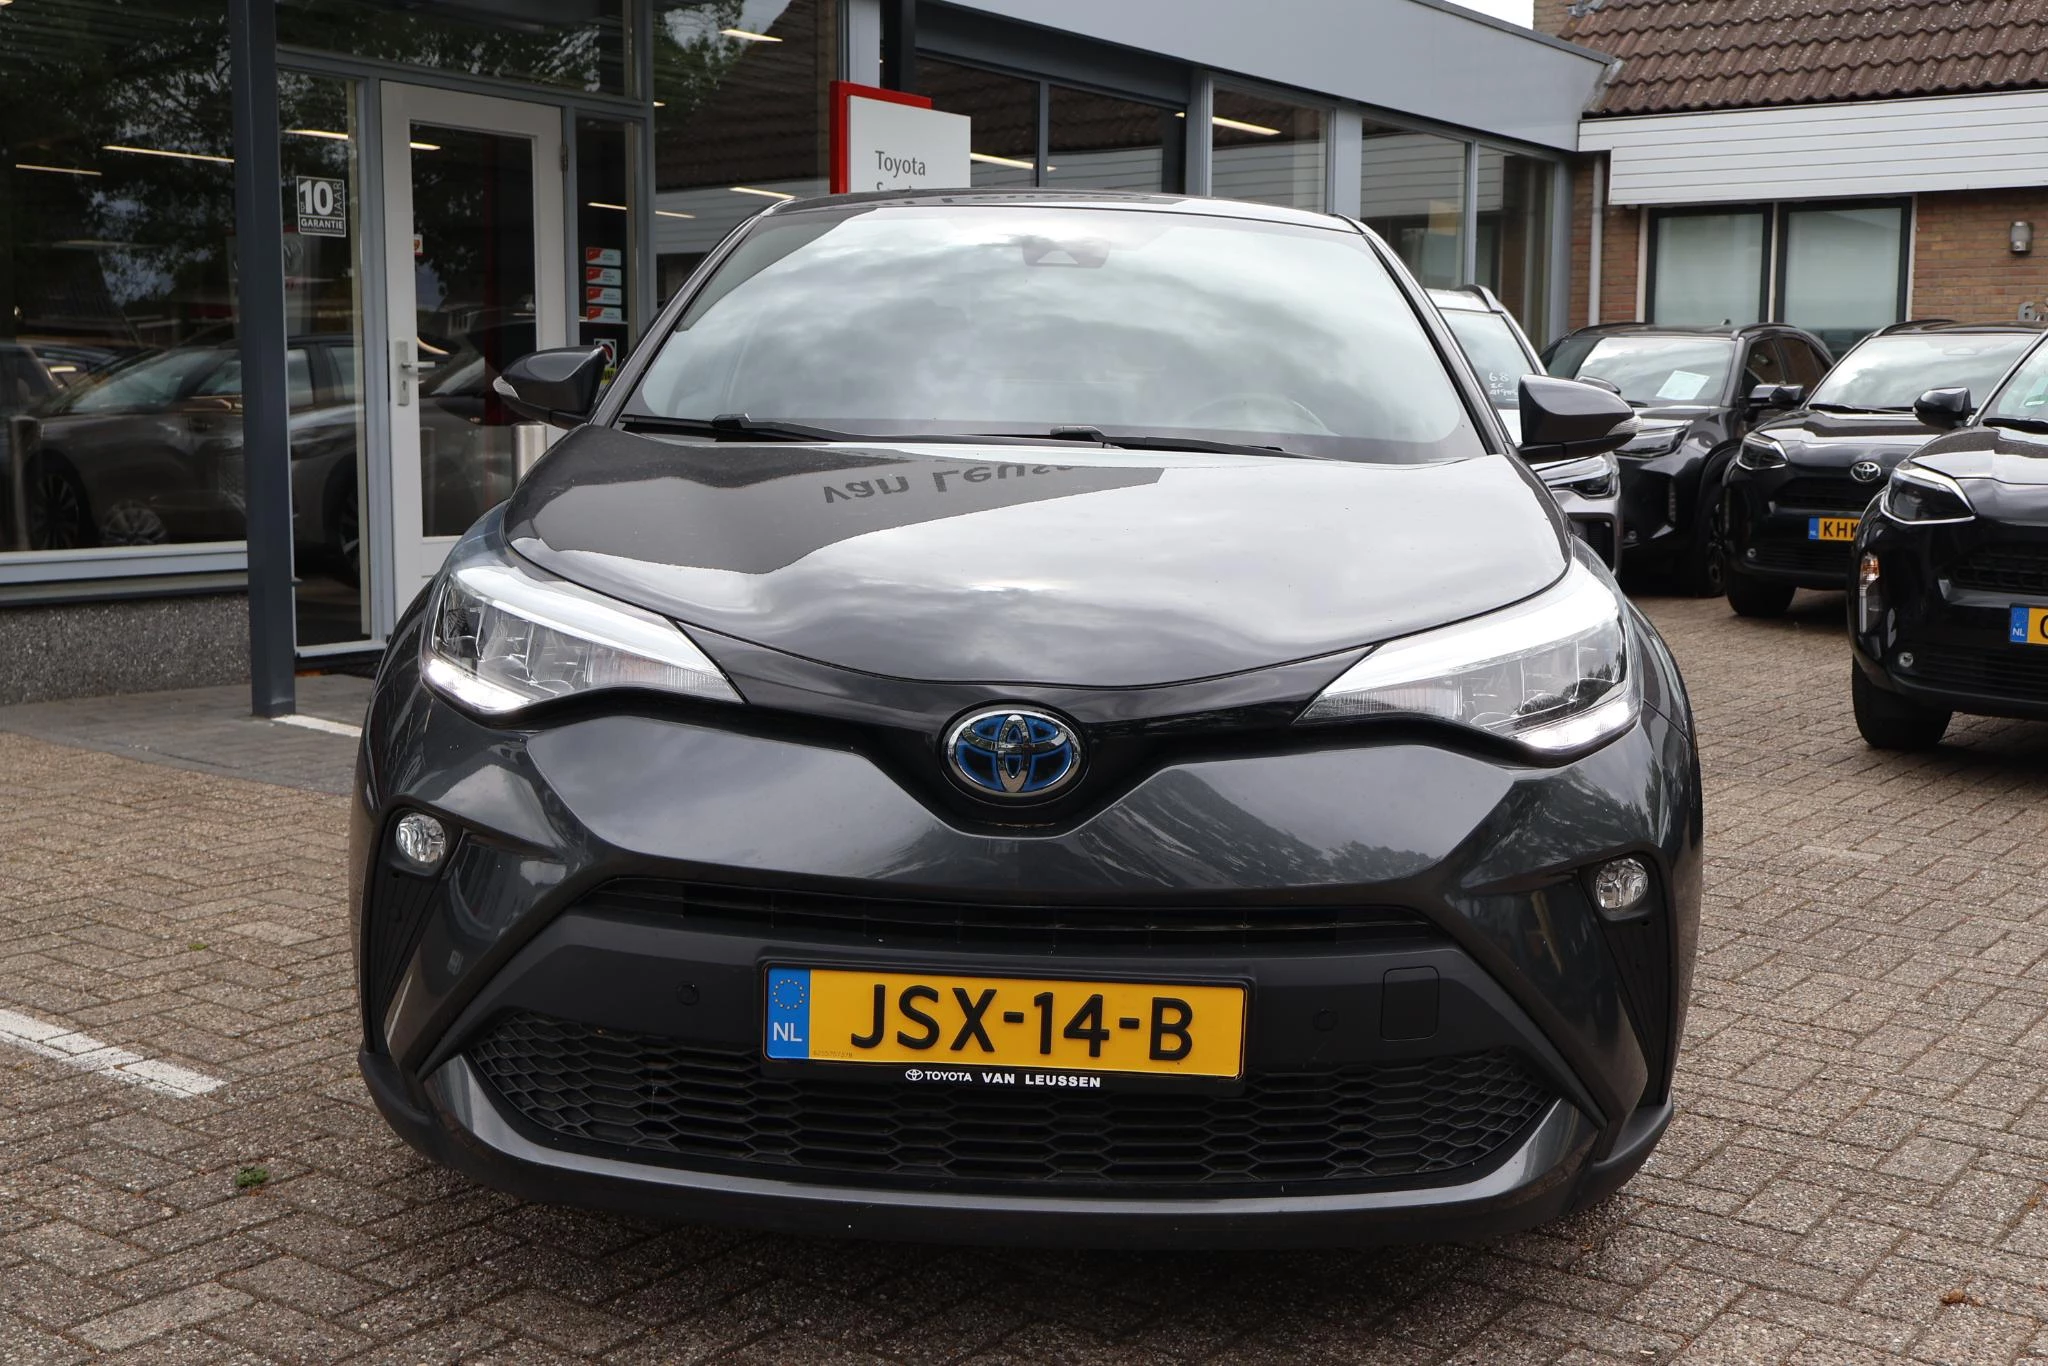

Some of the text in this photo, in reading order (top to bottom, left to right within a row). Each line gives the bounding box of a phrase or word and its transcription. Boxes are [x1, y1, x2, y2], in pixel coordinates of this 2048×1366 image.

[875, 151, 926, 176] Toyota
[300, 180, 334, 216] 10
[334, 182, 343, 216] JAAR
[301, 219, 343, 229] GARANTIE
[2012, 628, 2025, 637] NL
[773, 984, 1193, 1060] NL JSX-14-B
[925, 1071, 1101, 1088] TOYOTA VAN LEUSSEN
